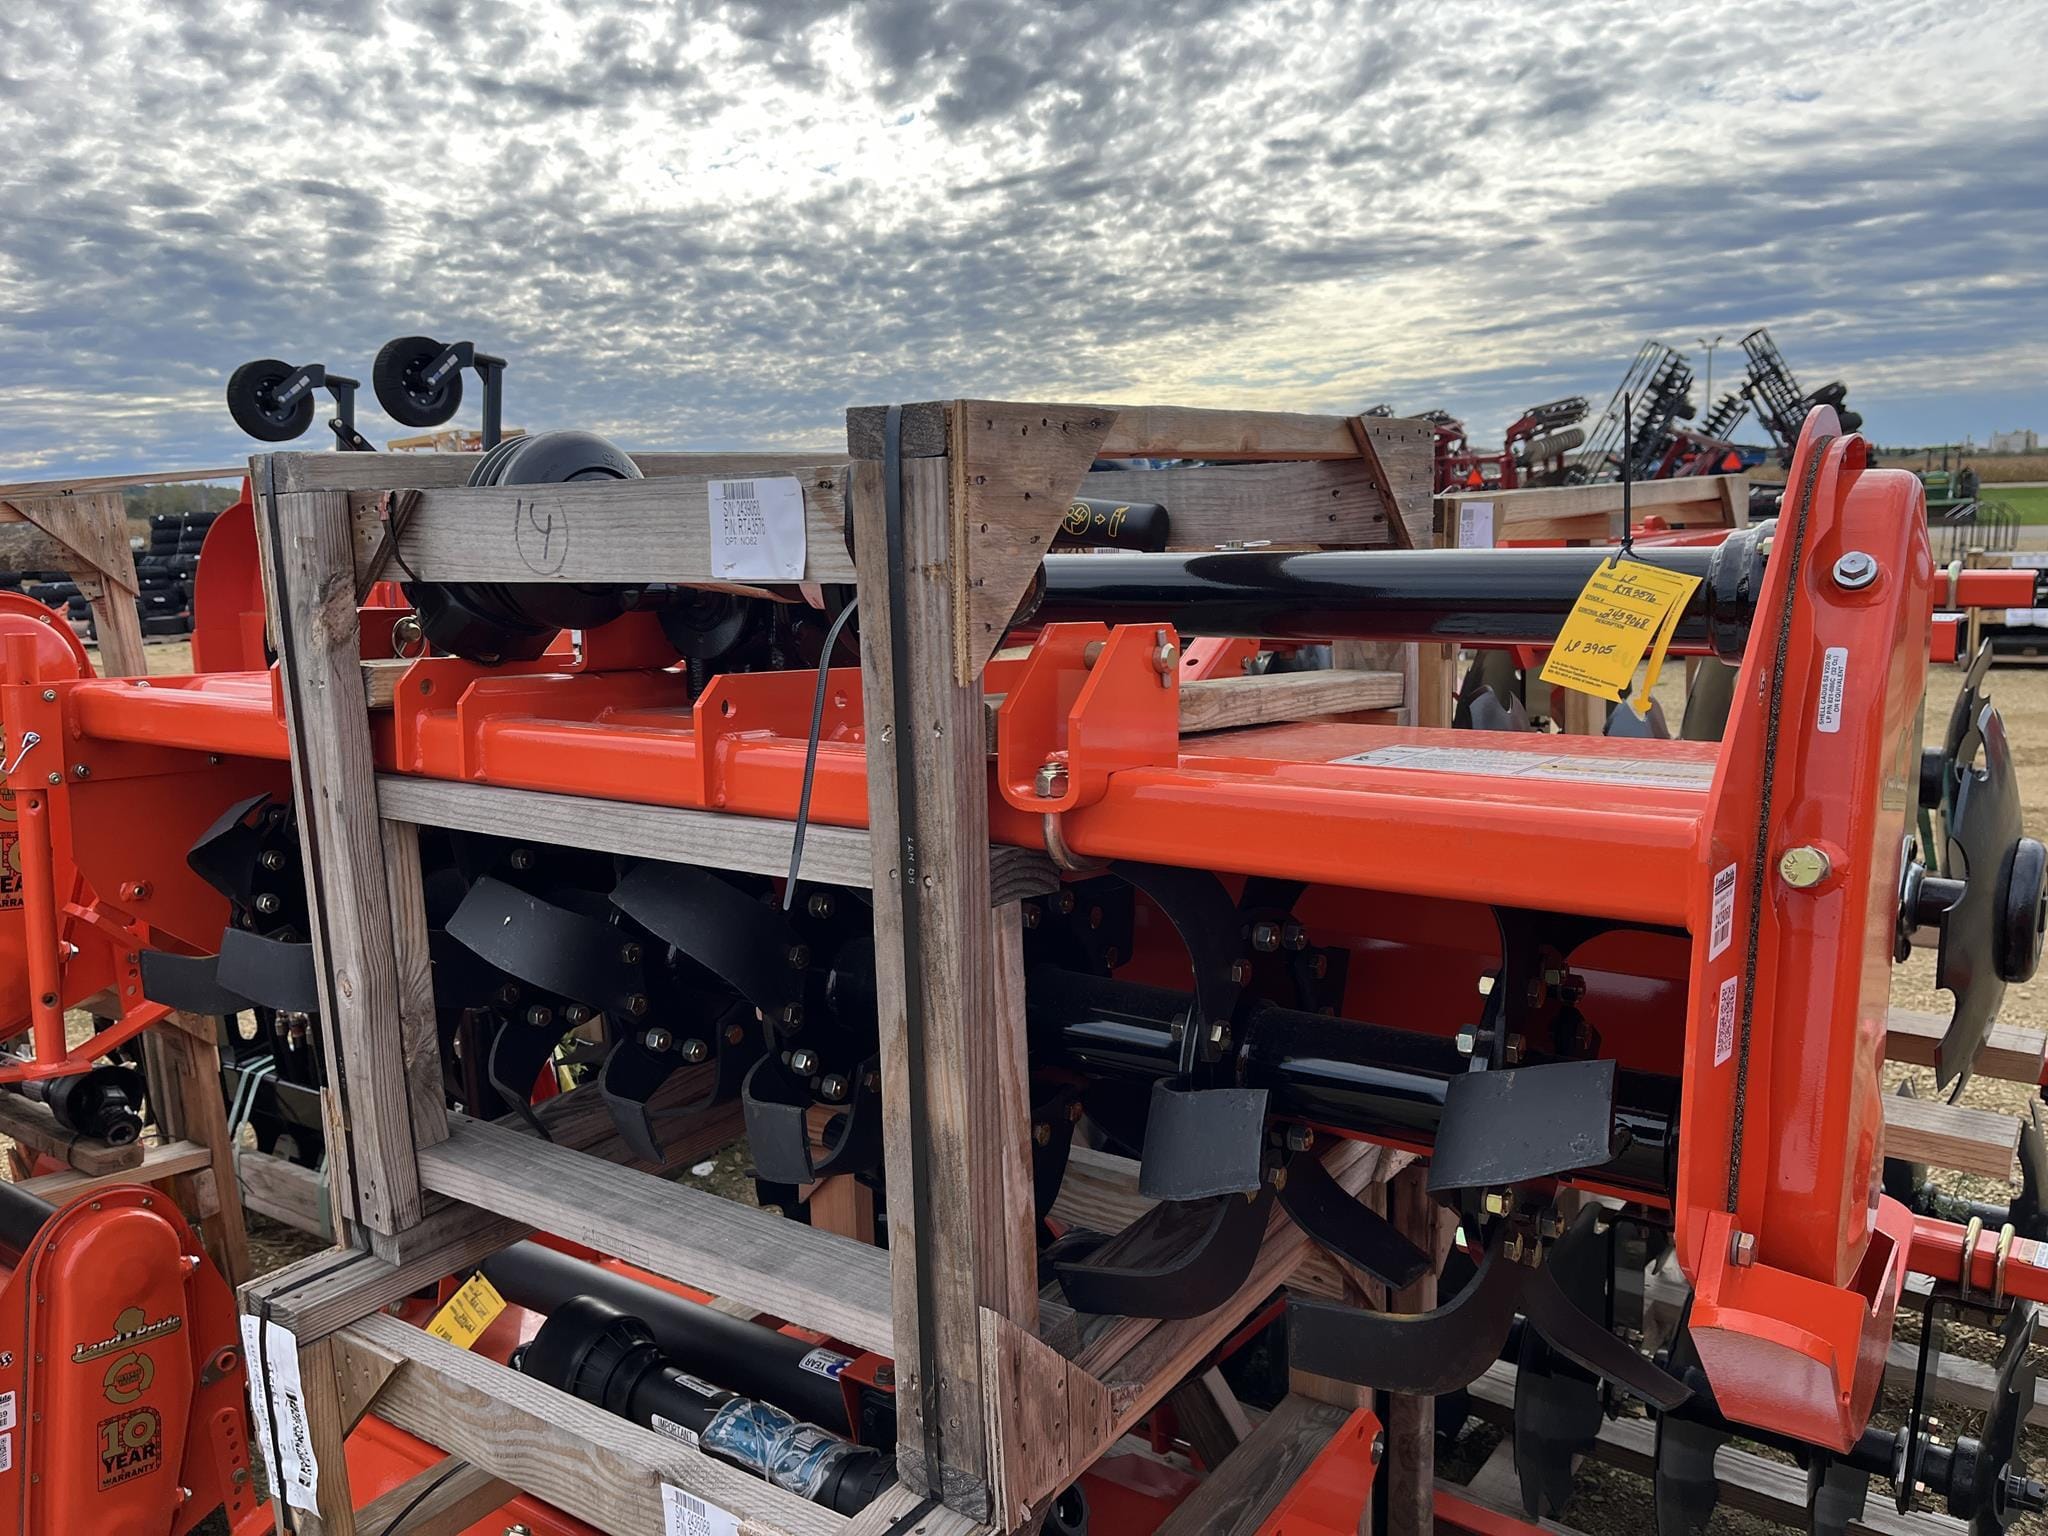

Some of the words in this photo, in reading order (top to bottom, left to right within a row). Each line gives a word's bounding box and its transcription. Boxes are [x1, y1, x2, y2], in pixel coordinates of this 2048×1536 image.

[738, 517, 765, 535] RTA3576
[1595, 617, 1625, 630] DESCRIPTION
[1582, 642, 1616, 656] 3905
[1834, 666, 1844, 702] EQUIVALENT
[1820, 685, 1828, 705] GADUS
[1818, 707, 1826, 725] SHELL
[1834, 703, 1840, 713] OR
[1826, 716, 1832, 724] LP
[76, 1333, 122, 1357] Land
[136, 1315, 181, 1337] Pride
[804, 1358, 826, 1371] YEAR
[102, 1412, 156, 1460] 10
[657, 1418, 692, 1443] IMPORTANT
[102, 1444, 155, 1474] YEAR
[103, 1462, 155, 1486] WARRANTY
